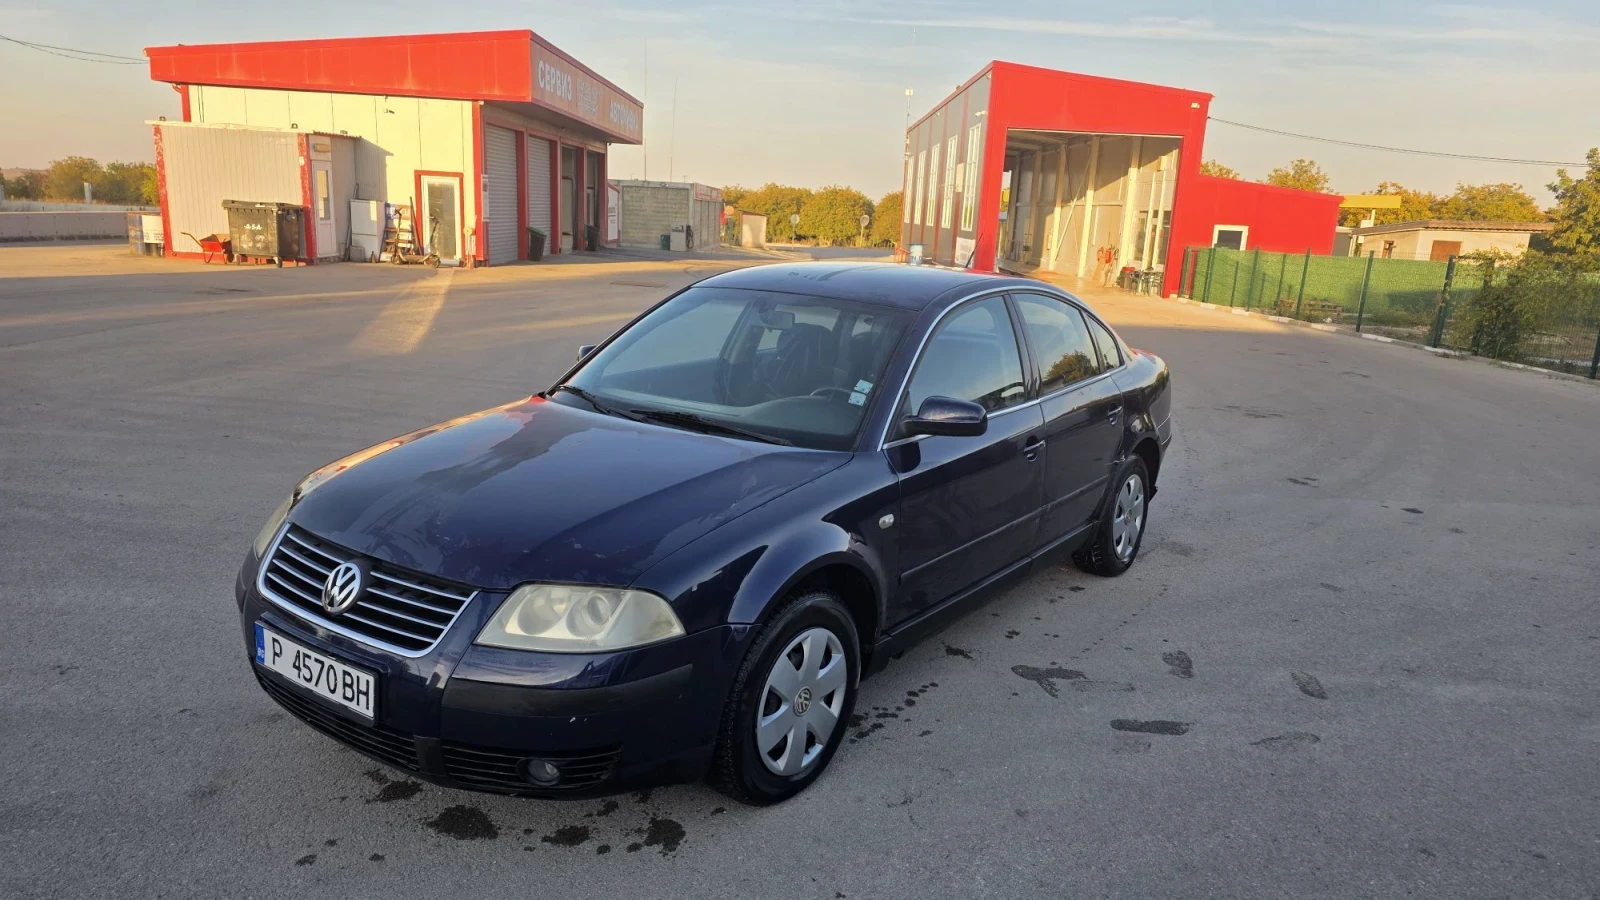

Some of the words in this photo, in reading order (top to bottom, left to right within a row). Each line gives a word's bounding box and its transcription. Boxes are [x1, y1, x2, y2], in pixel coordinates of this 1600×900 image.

[538, 60, 572, 101] СЕРВИЗ
[271, 636, 283, 666] P
[292, 649, 338, 695] 4570
[342, 669, 370, 711] BH
